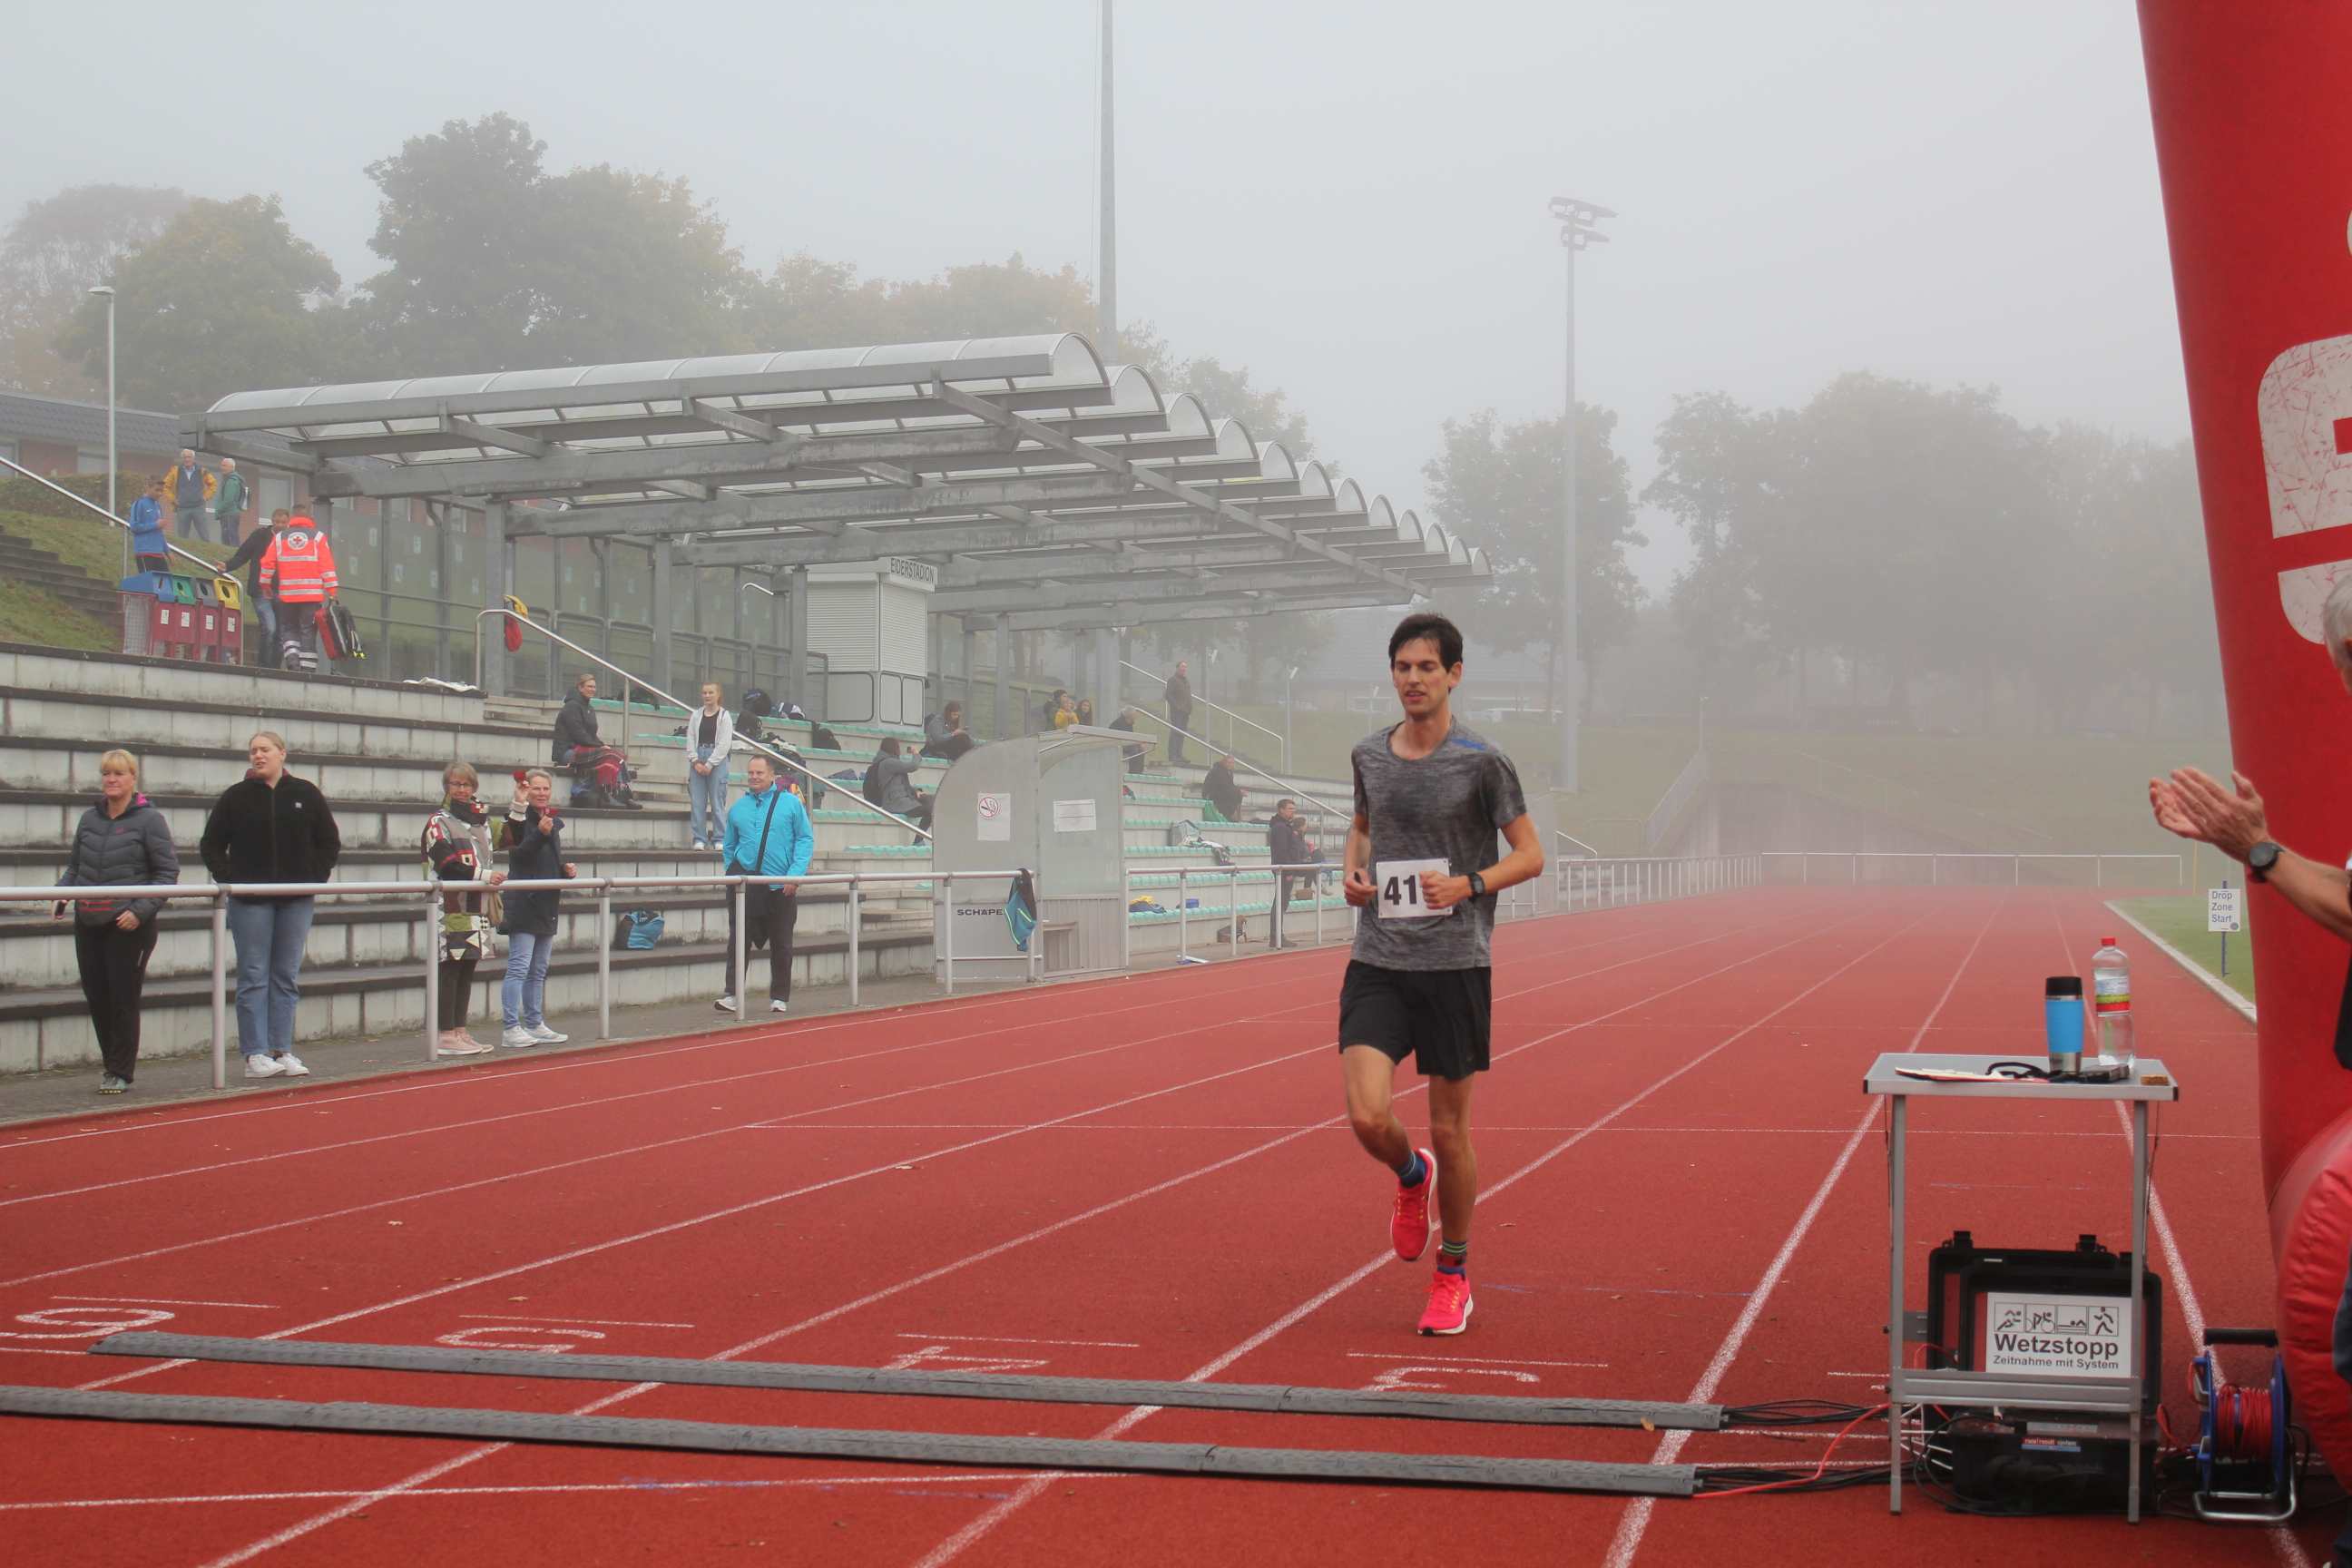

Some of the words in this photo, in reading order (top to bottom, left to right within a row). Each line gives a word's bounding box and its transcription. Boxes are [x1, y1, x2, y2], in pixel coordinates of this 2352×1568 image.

[890, 557, 935, 583] EIDERSTADION
[1384, 875, 1422, 906] 41
[2211, 891, 2233, 901] Drop
[2211, 902, 2235, 911] Zone
[2211, 914, 2232, 923] Start
[1994, 1333, 2119, 1360] Wetzstopp
[1993, 1355, 2053, 1367] Zeitnahme
[2055, 1357, 2073, 1367] mit
[2076, 1358, 2119, 1370] System
